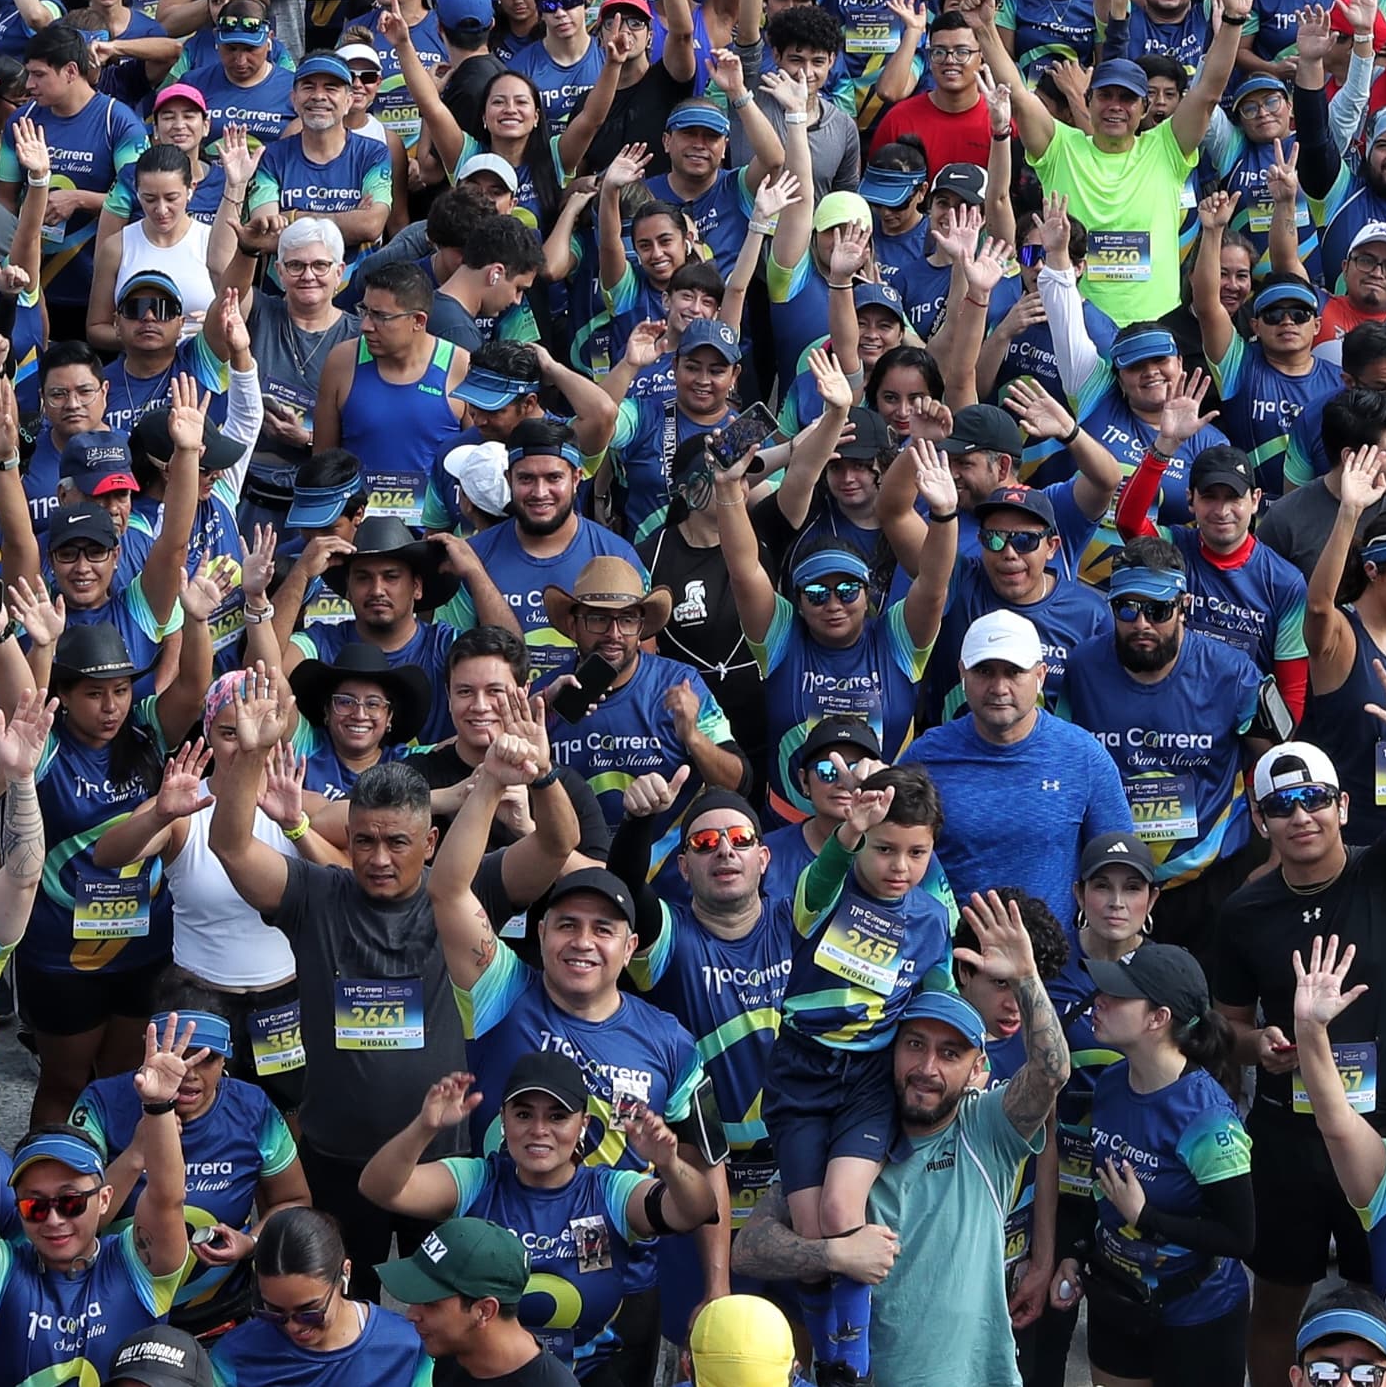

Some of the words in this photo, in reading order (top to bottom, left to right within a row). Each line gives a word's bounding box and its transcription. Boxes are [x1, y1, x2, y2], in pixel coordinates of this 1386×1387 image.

[855, 26, 890, 39] 3272
[1098, 250, 1139, 264] 3240
[1126, 727, 1212, 750] Carrera
[1140, 830, 1176, 839] MEDALLA
[87, 901, 138, 918] 0399
[95, 928, 129, 937] MEDALLA
[844, 929, 898, 963] 2657
[839, 965, 876, 988] MEDALLA
[351, 1006, 406, 1027] 2641
[359, 1039, 399, 1047] MEDALLA
[139, 1342, 185, 1362] PROGRAM
